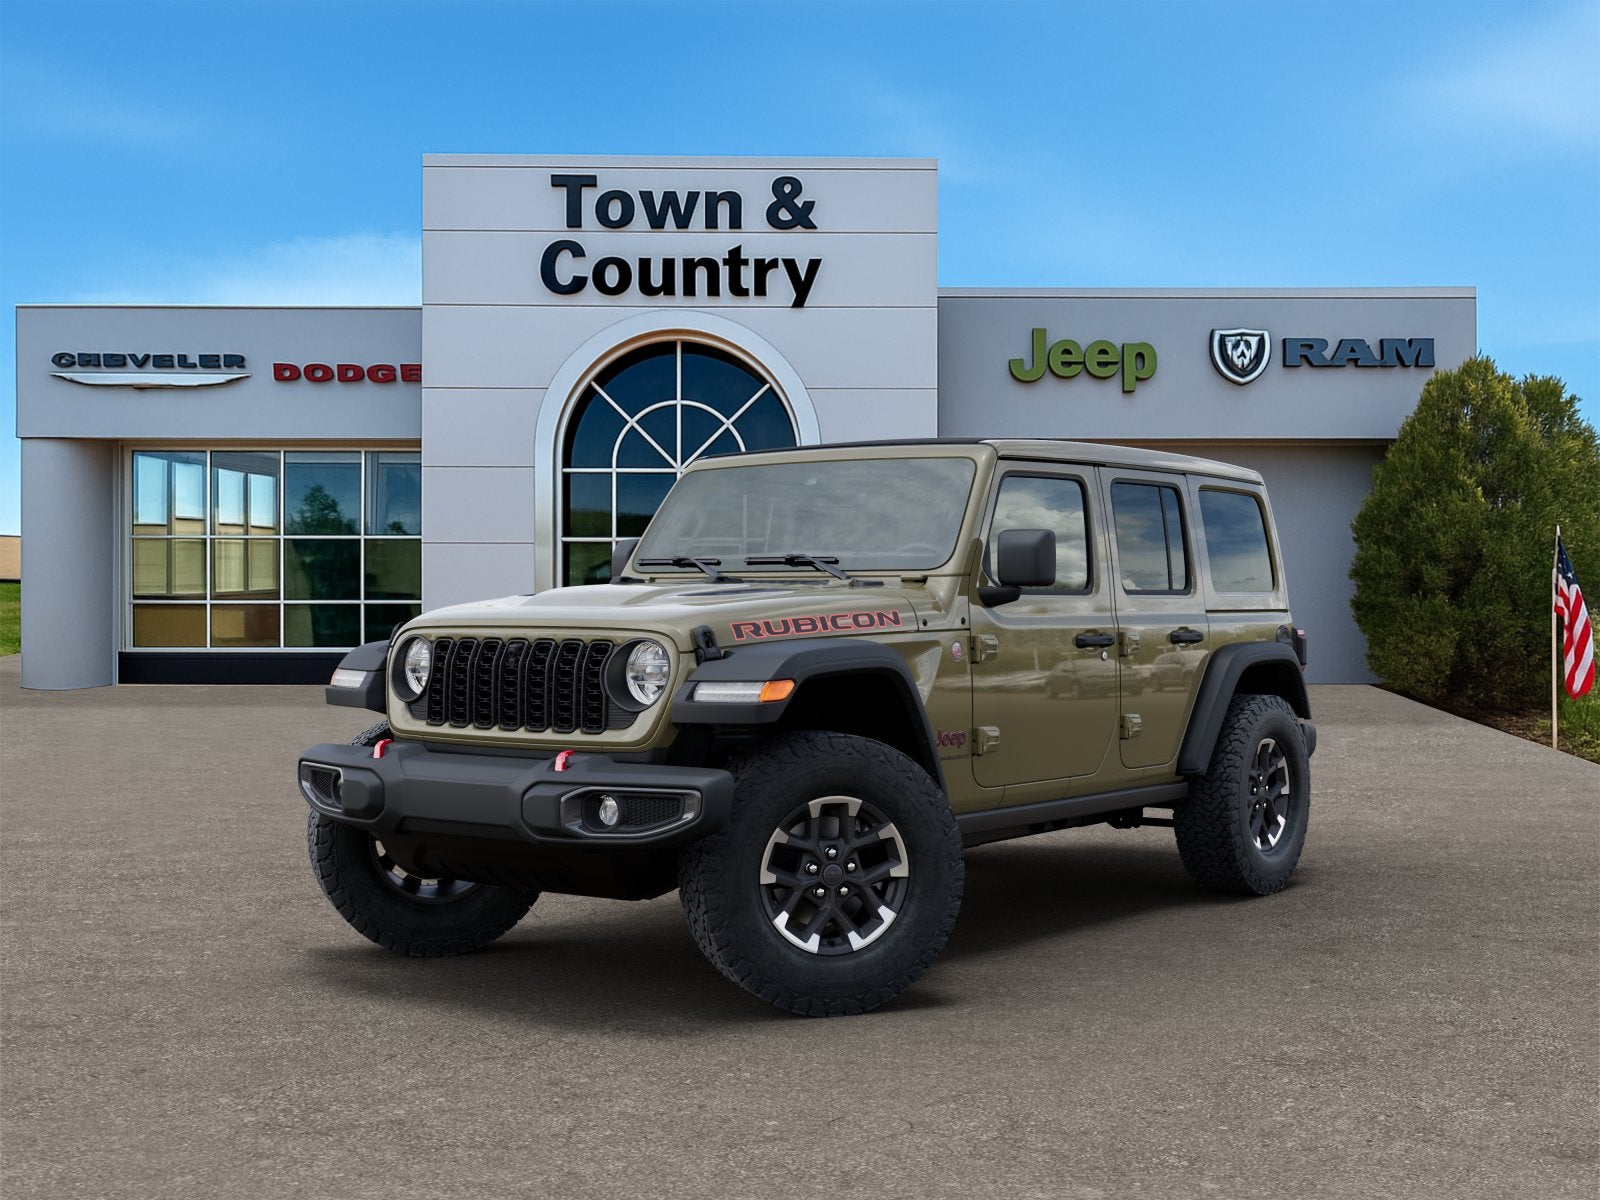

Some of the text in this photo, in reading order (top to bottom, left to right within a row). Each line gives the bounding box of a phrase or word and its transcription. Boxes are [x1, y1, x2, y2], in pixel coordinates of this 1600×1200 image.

[551, 174, 818, 230] Town &
[540, 239, 822, 308] Country
[1009, 328, 1158, 393] Jeep
[1283, 338, 1436, 368] RAM
[273, 363, 422, 383] DODGE
[730, 609, 902, 640] RUBICON
[936, 728, 966, 748] Jeep
